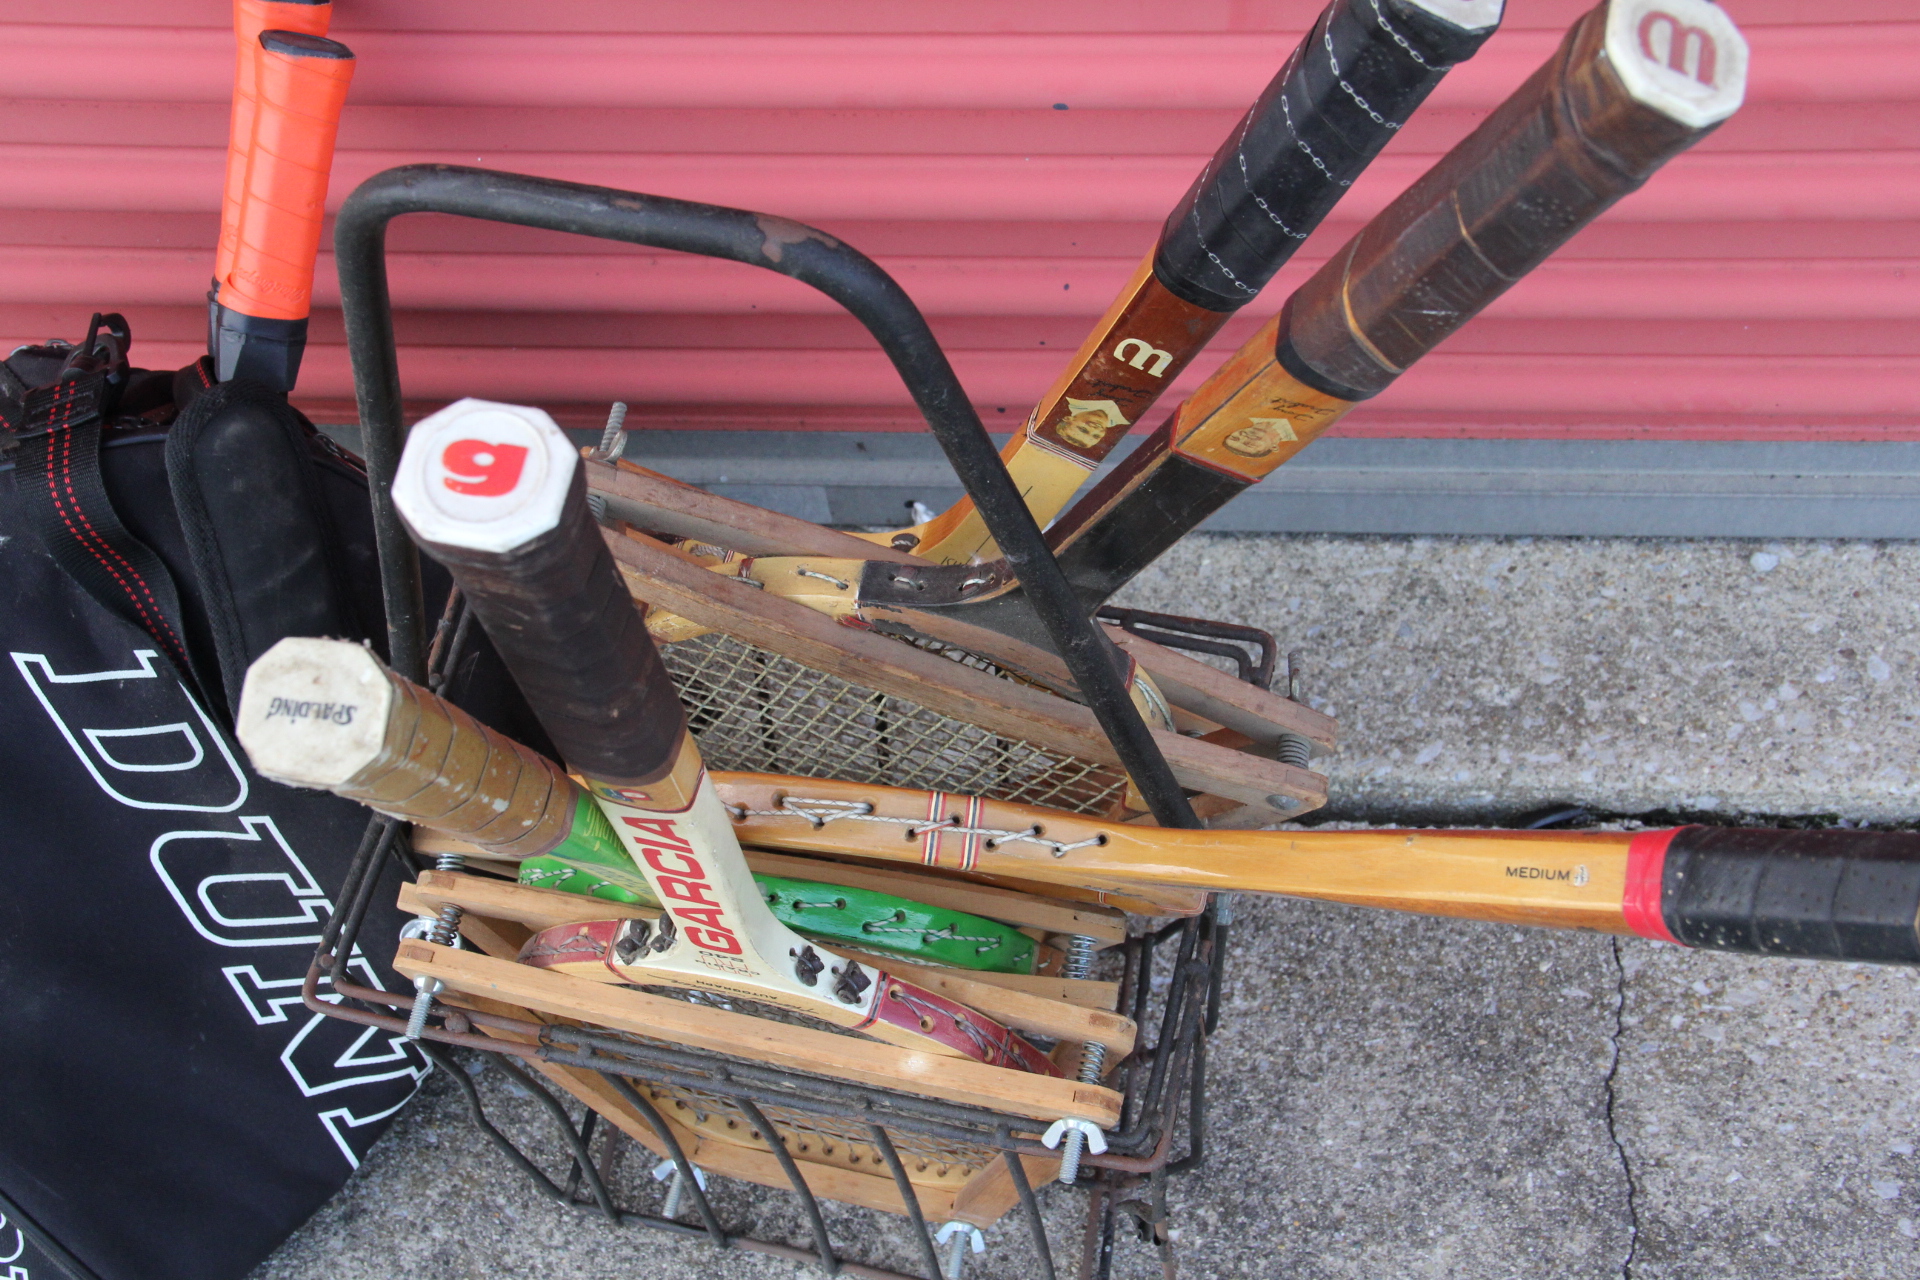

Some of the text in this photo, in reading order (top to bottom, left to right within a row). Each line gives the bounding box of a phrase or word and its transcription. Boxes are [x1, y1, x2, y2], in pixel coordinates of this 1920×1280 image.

[265, 696, 358, 726] SPALDING
[622, 815, 743, 956] GARCIA
[1506, 866, 1570, 882] MEDIUM
[696, 979, 777, 999] AUTOGRAPH
